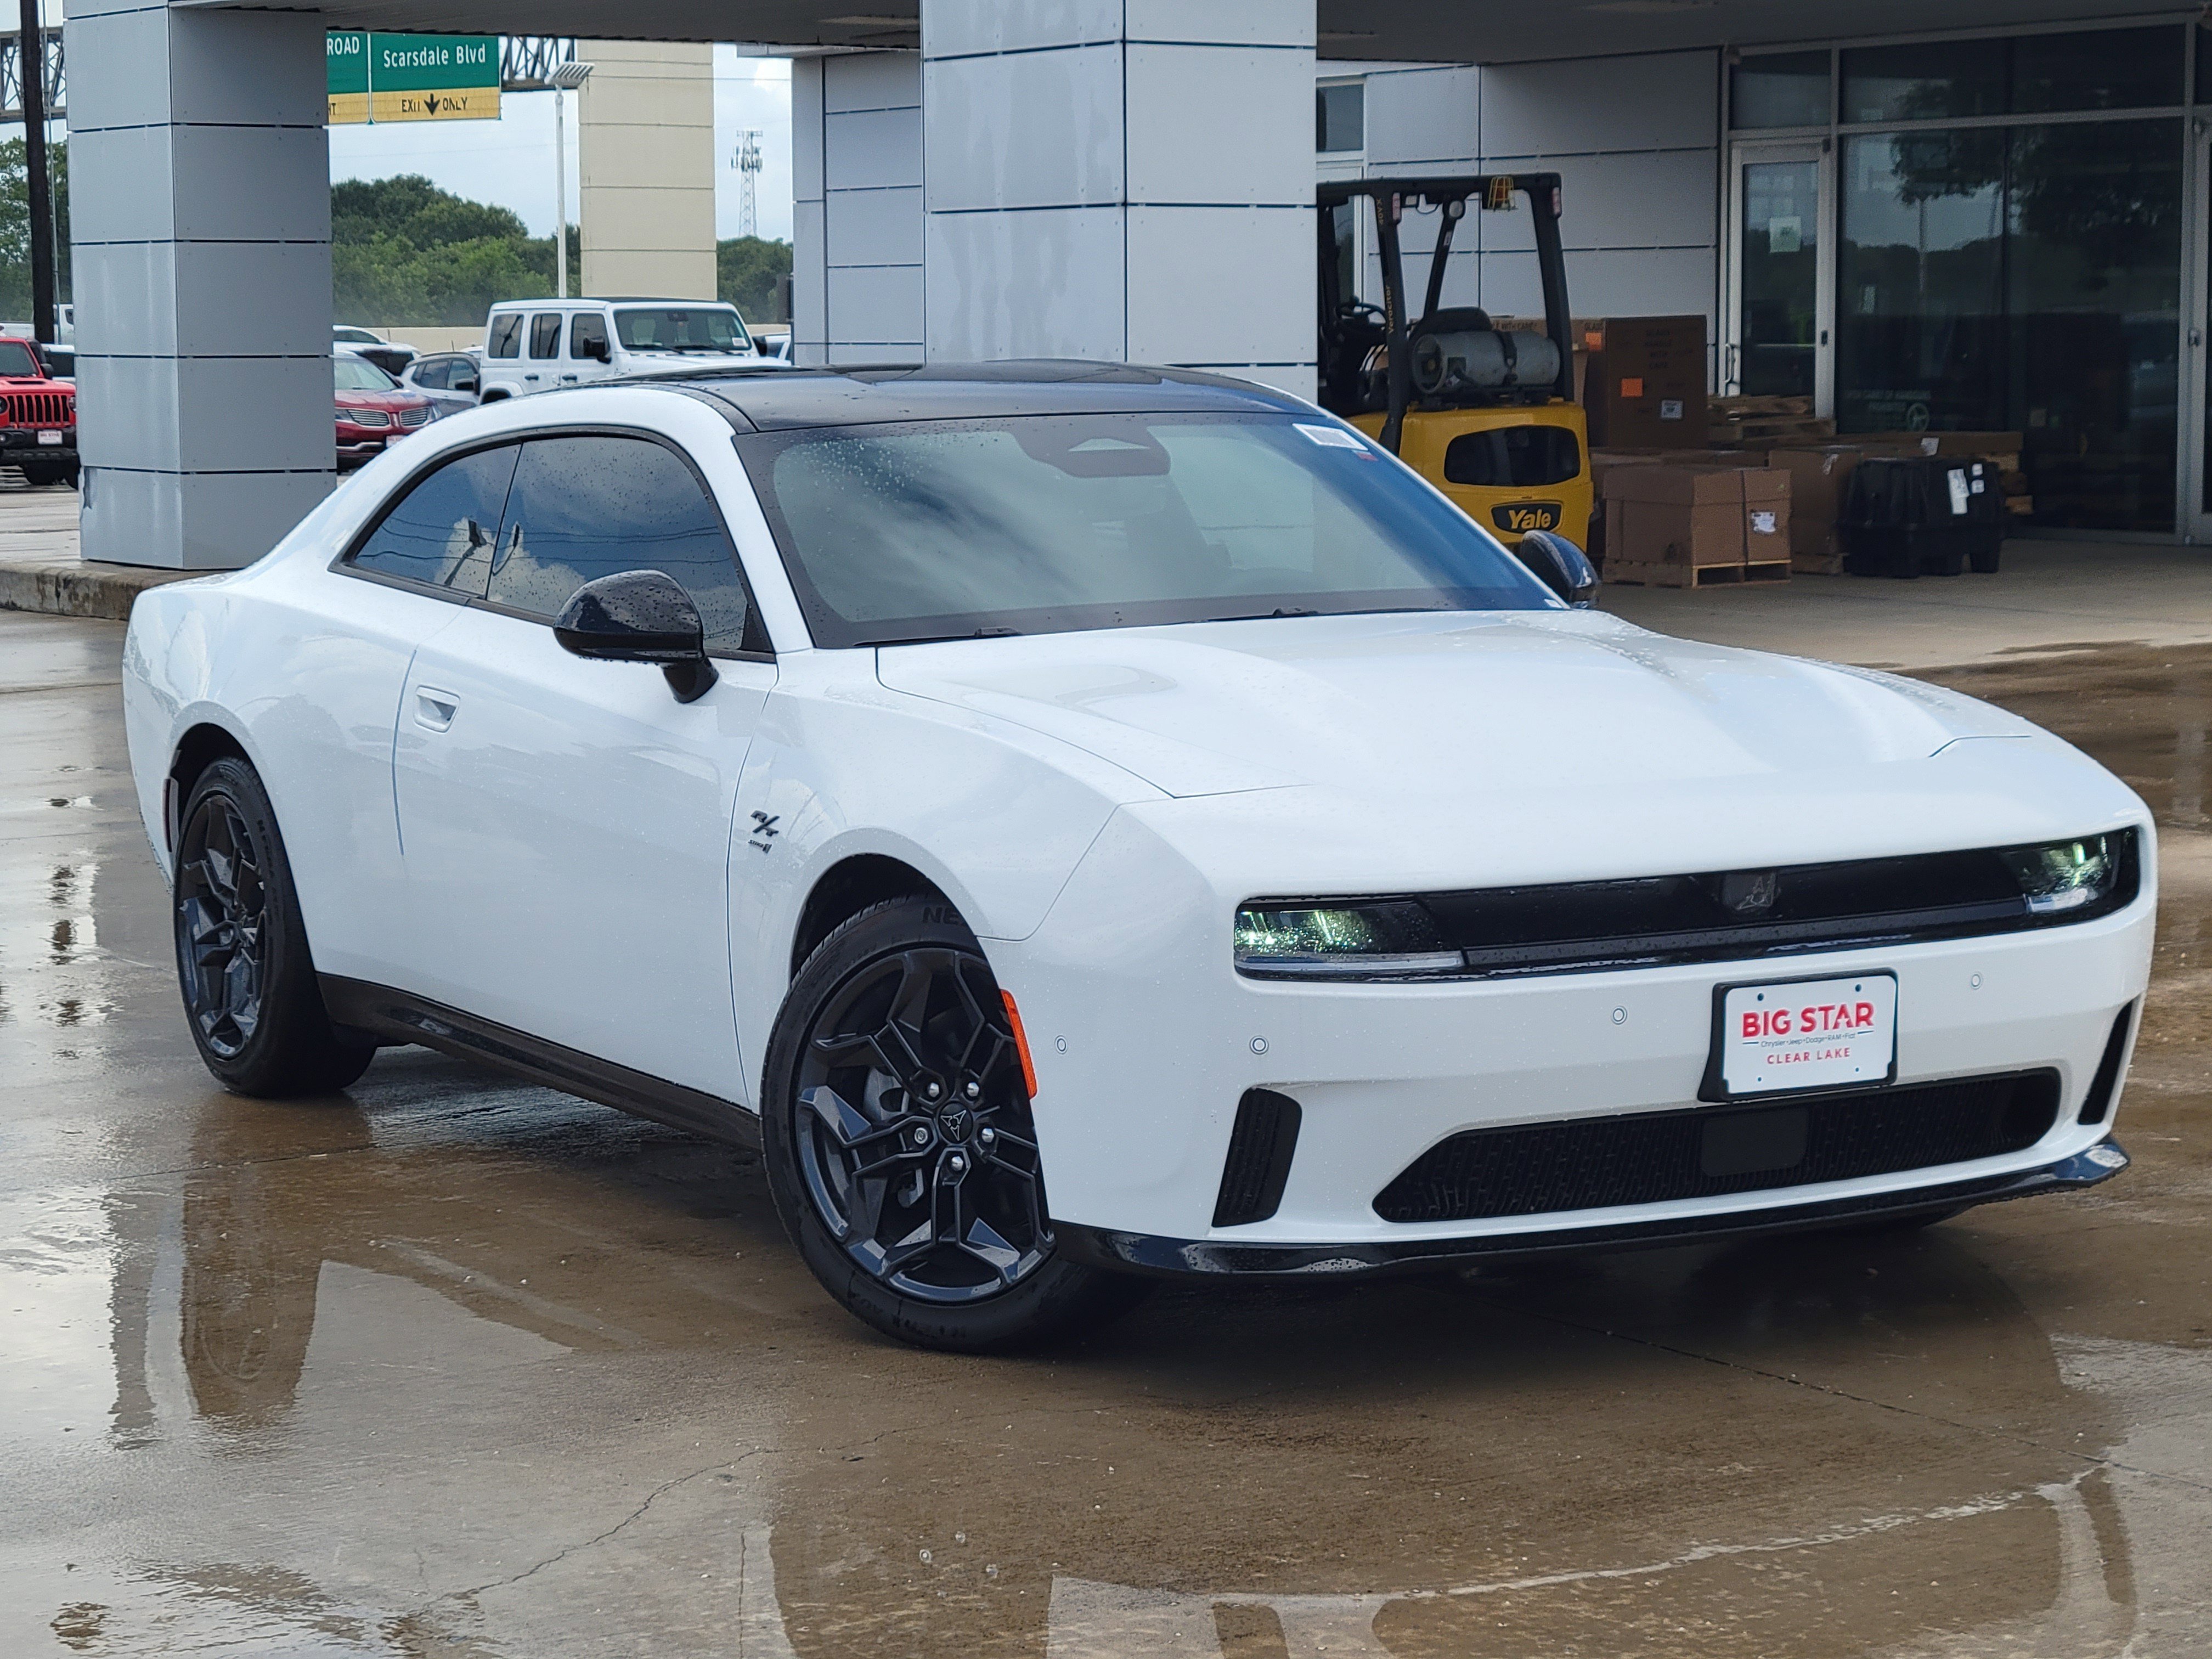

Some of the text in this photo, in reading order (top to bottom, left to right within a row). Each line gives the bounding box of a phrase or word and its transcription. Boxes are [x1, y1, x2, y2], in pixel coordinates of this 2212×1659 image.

[327, 37, 360, 55] ROAD
[383, 43, 486, 68] Scarsdale Blvd
[402, 97, 468, 112] EXIT ONLY
[1385, 284, 1395, 334] Veracitor
[1509, 509, 1551, 529] Yale
[922, 906, 968, 927] NE
[1742, 1002, 1875, 1038] BIG STAR
[1767, 1047, 1850, 1064] CLEAR LAKE
